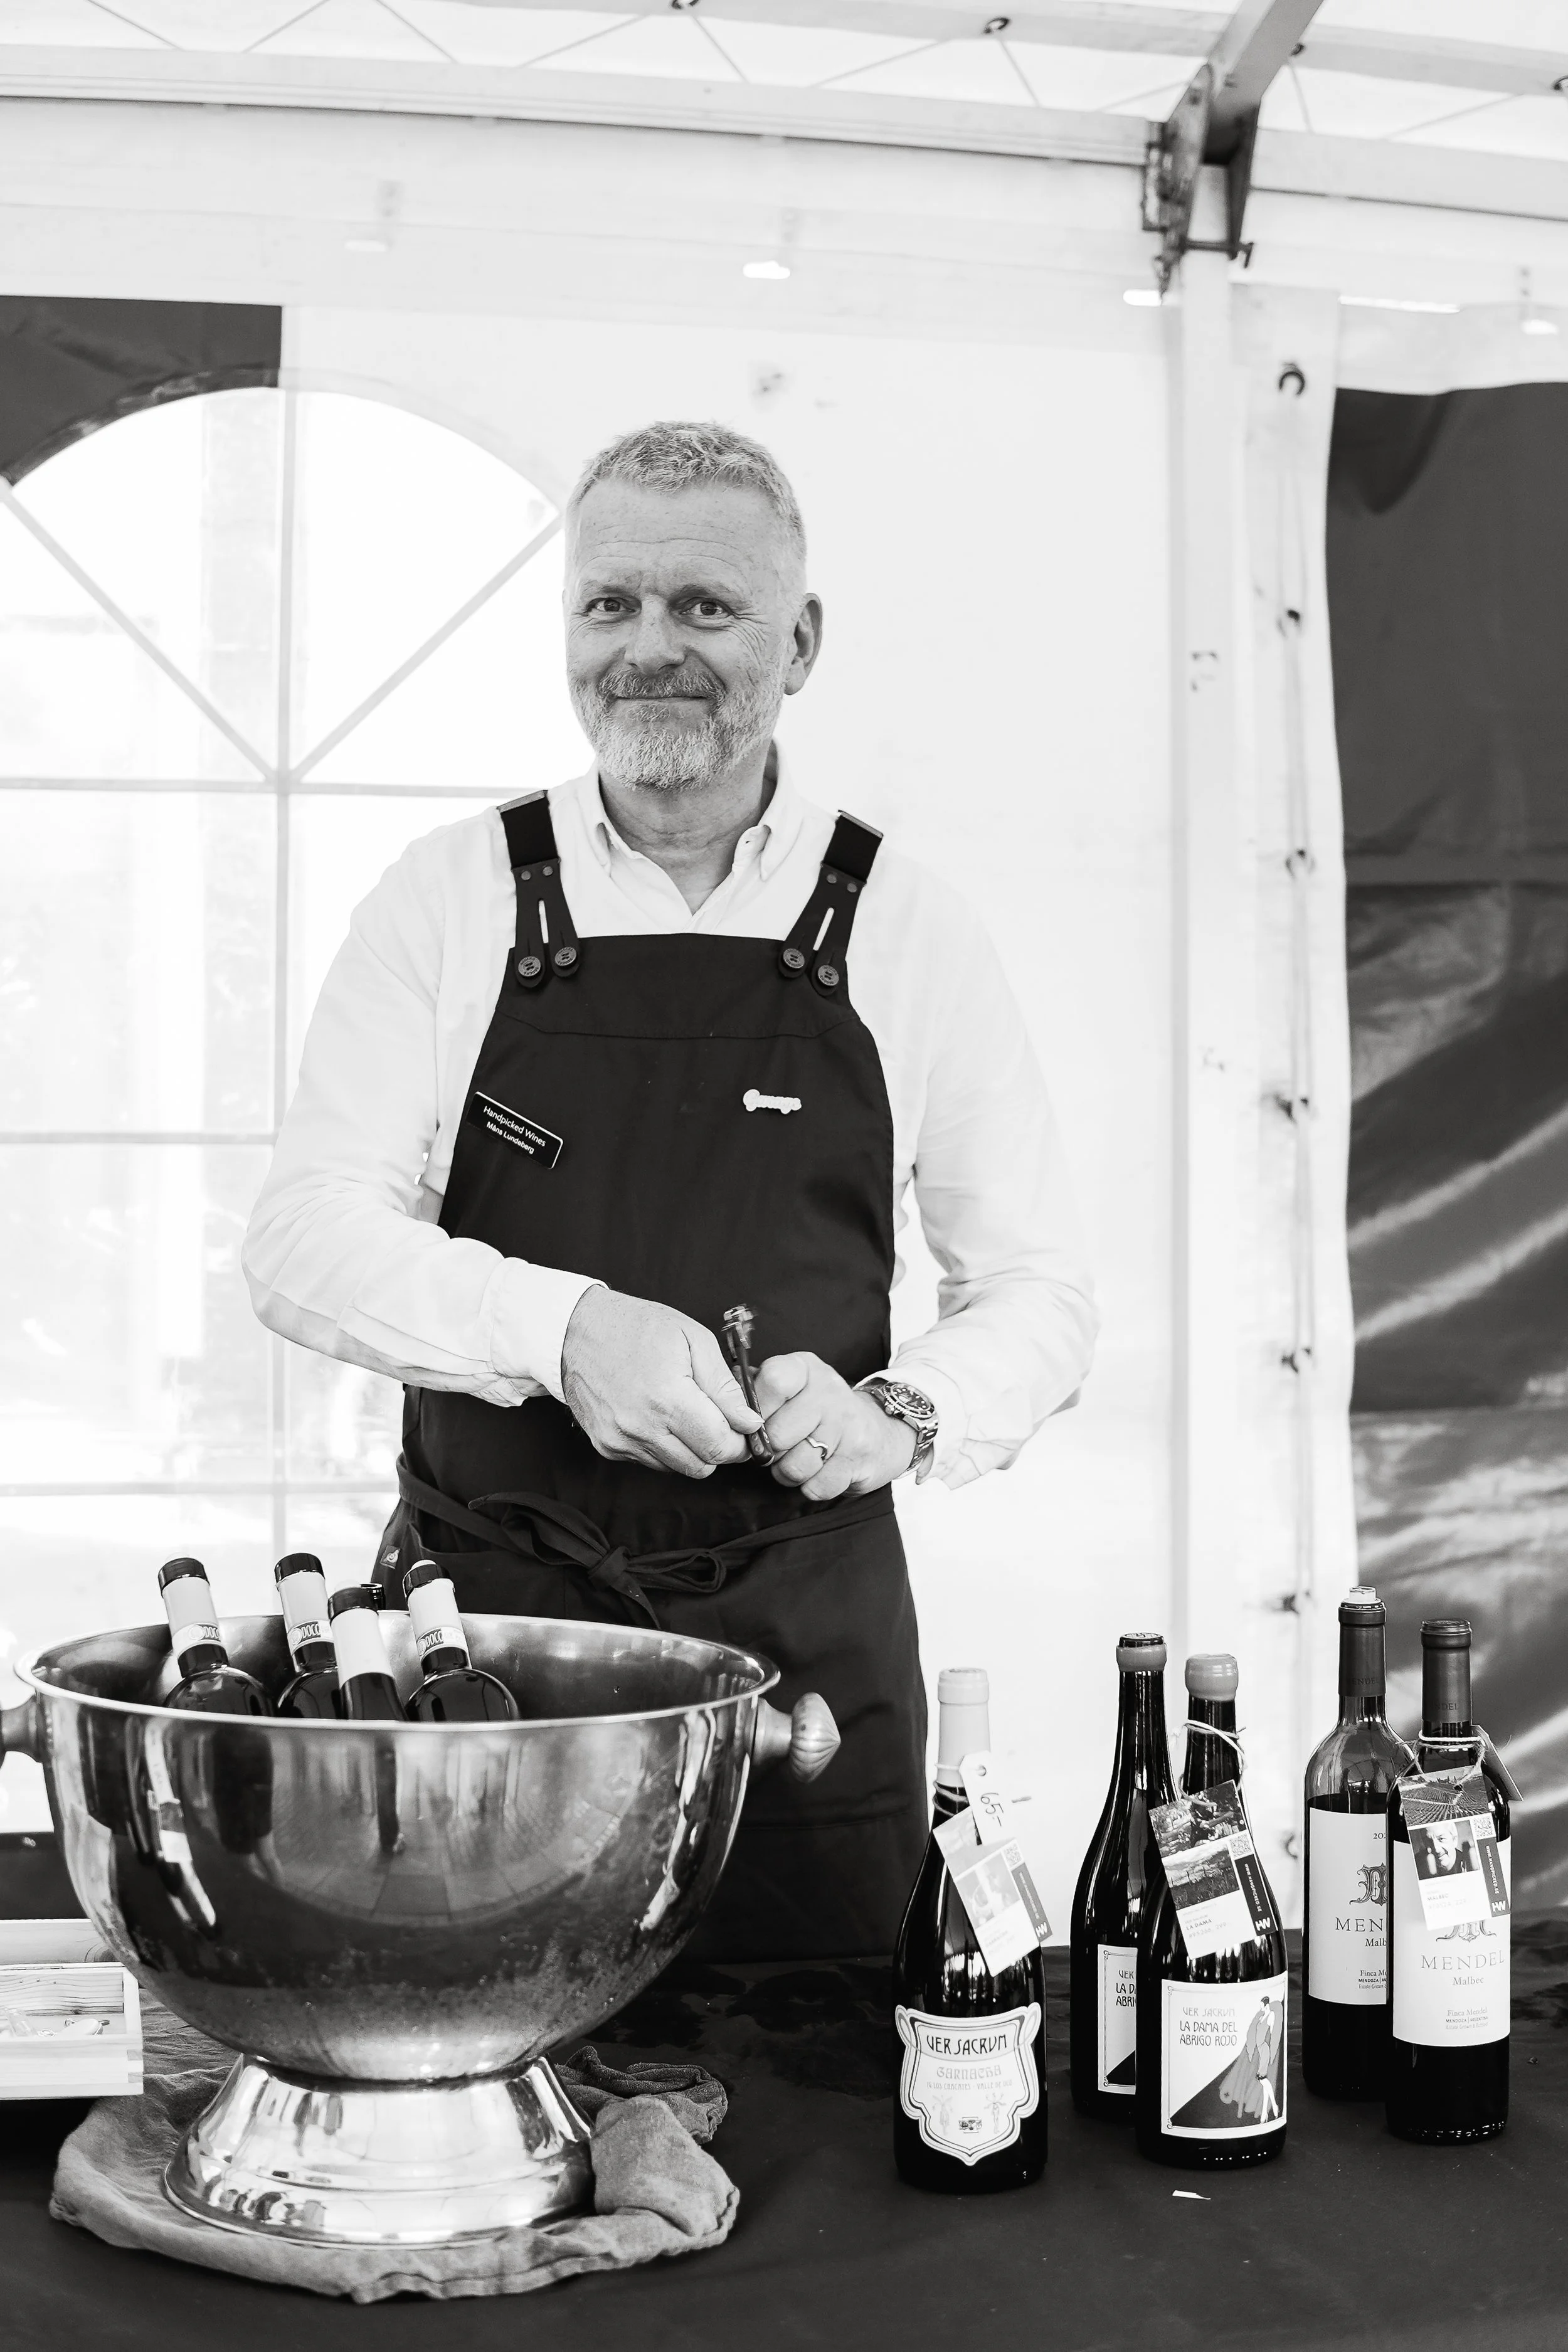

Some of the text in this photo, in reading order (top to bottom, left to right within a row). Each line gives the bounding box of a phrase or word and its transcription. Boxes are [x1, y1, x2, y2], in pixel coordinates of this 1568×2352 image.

[484, 1106, 546, 1147] Handpicked Wines
[503, 1131, 535, 1155] Lundeberg
[1491, 1900, 1506, 1912] HW
[1255, 1917, 1271, 1931] HW
[1420, 1949, 1505, 1970] MENDEL
[1452, 1976, 1485, 1986] Malbec
[1116, 1983, 1136, 1994] LA D
[1116, 1996, 1136, 2007] ABRI
[1183, 2006, 1199, 2016] VER
[1466, 2006, 1487, 2016] Mendel
[1180, 2020, 1237, 2032] LA DAMA DEL
[926, 2035, 951, 2055] VER
[1180, 2034, 1237, 2047] ABRIGO ROJO
[936, 2064, 1002, 2080] GARNACHA
